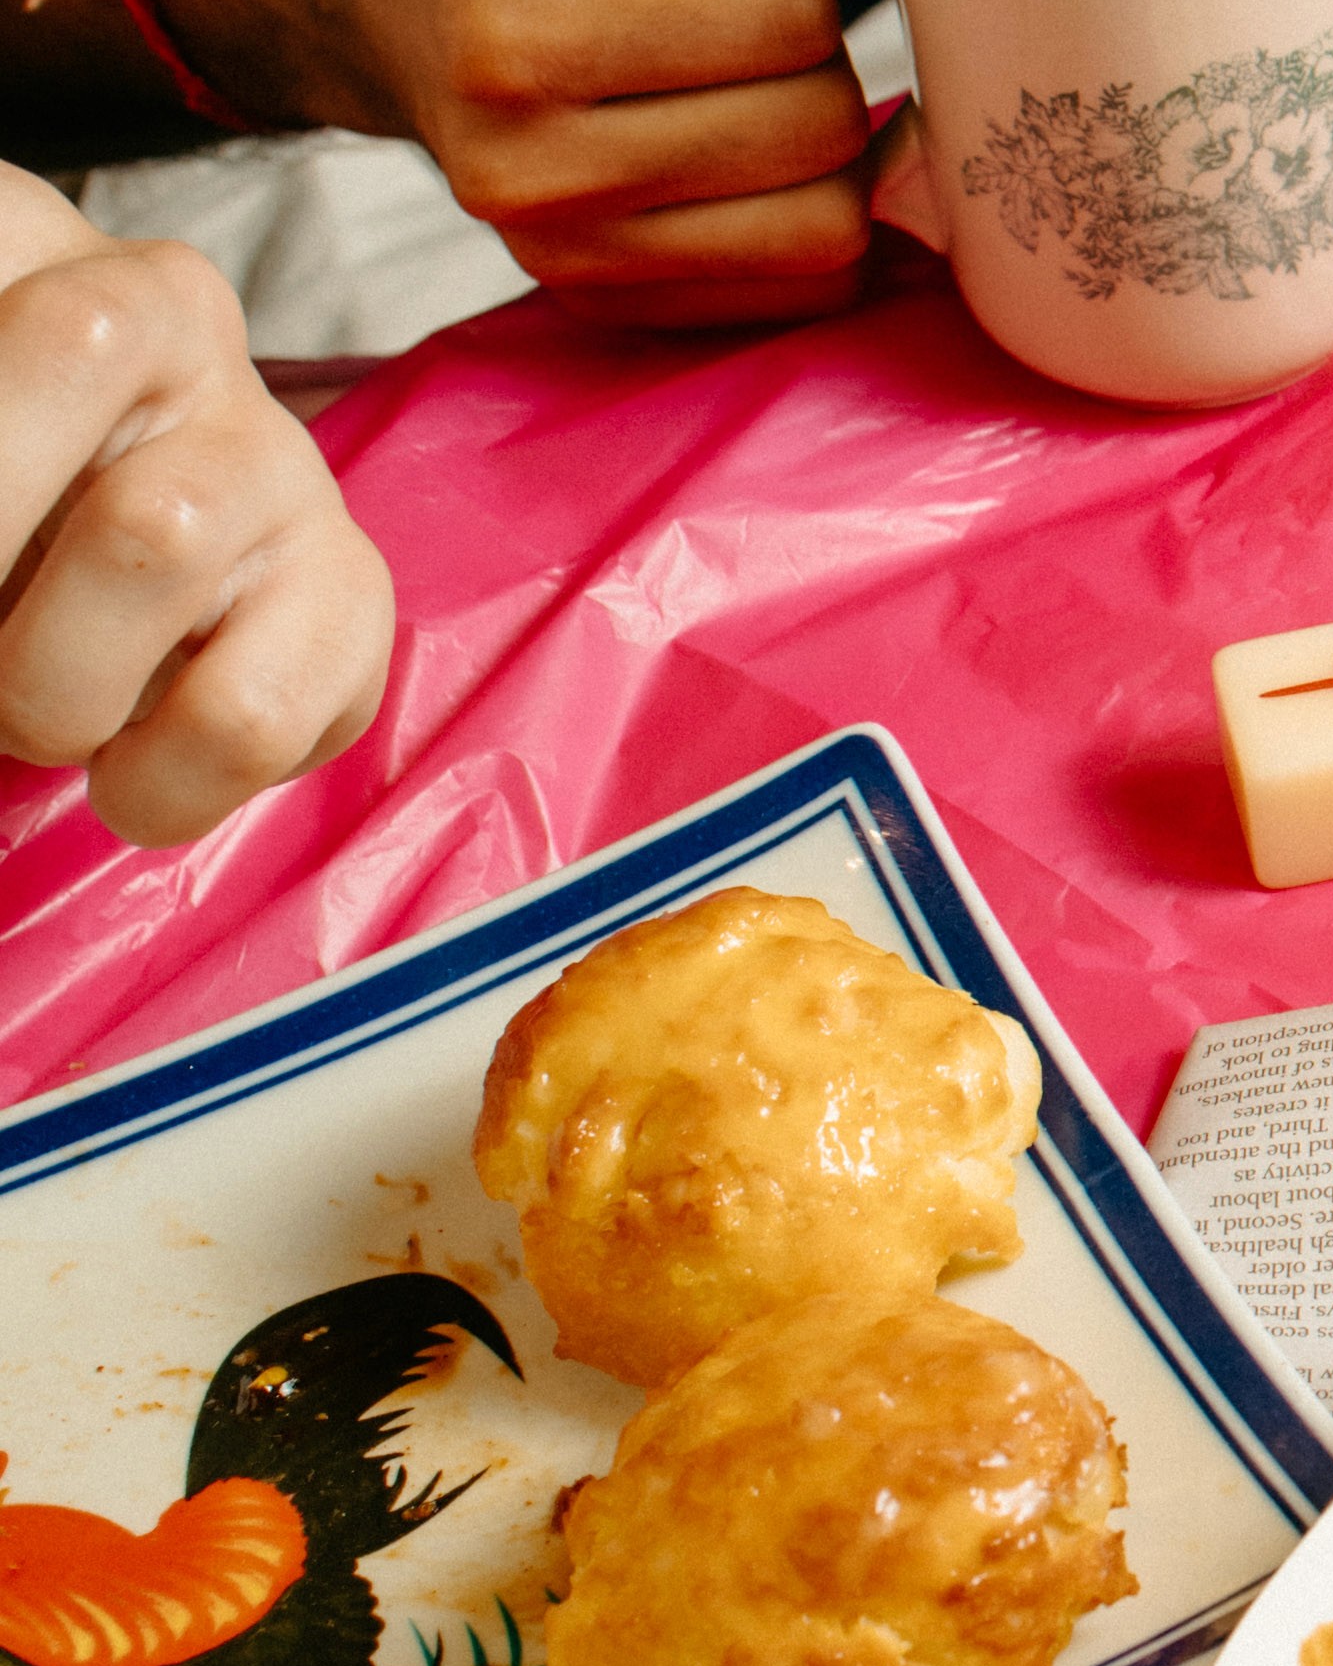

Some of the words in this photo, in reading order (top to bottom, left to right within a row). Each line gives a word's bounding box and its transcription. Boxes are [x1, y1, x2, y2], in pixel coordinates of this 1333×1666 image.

[1202, 1042, 1225, 1059] of
[1271, 1046, 1290, 1058] to
[1221, 1051, 1263, 1071] look
[1291, 1060, 1314, 1077] of
[1197, 1083, 1285, 1107] markets,
[1314, 1097, 1329, 1111] it
[1233, 1099, 1307, 1119] creates
[1216, 1126, 1255, 1145] and
[1263, 1118, 1328, 1139] Third,
[1177, 1132, 1208, 1147] too
[1160, 1146, 1260, 1171] attendant
[1266, 1142, 1300, 1159] the
[1233, 1169, 1256, 1182] as
[1209, 1191, 1278, 1210] labour
[1217, 1213, 1302, 1236] Second,
[1204, 1238, 1302, 1257] healthca
[1248, 1262, 1305, 1279] older
